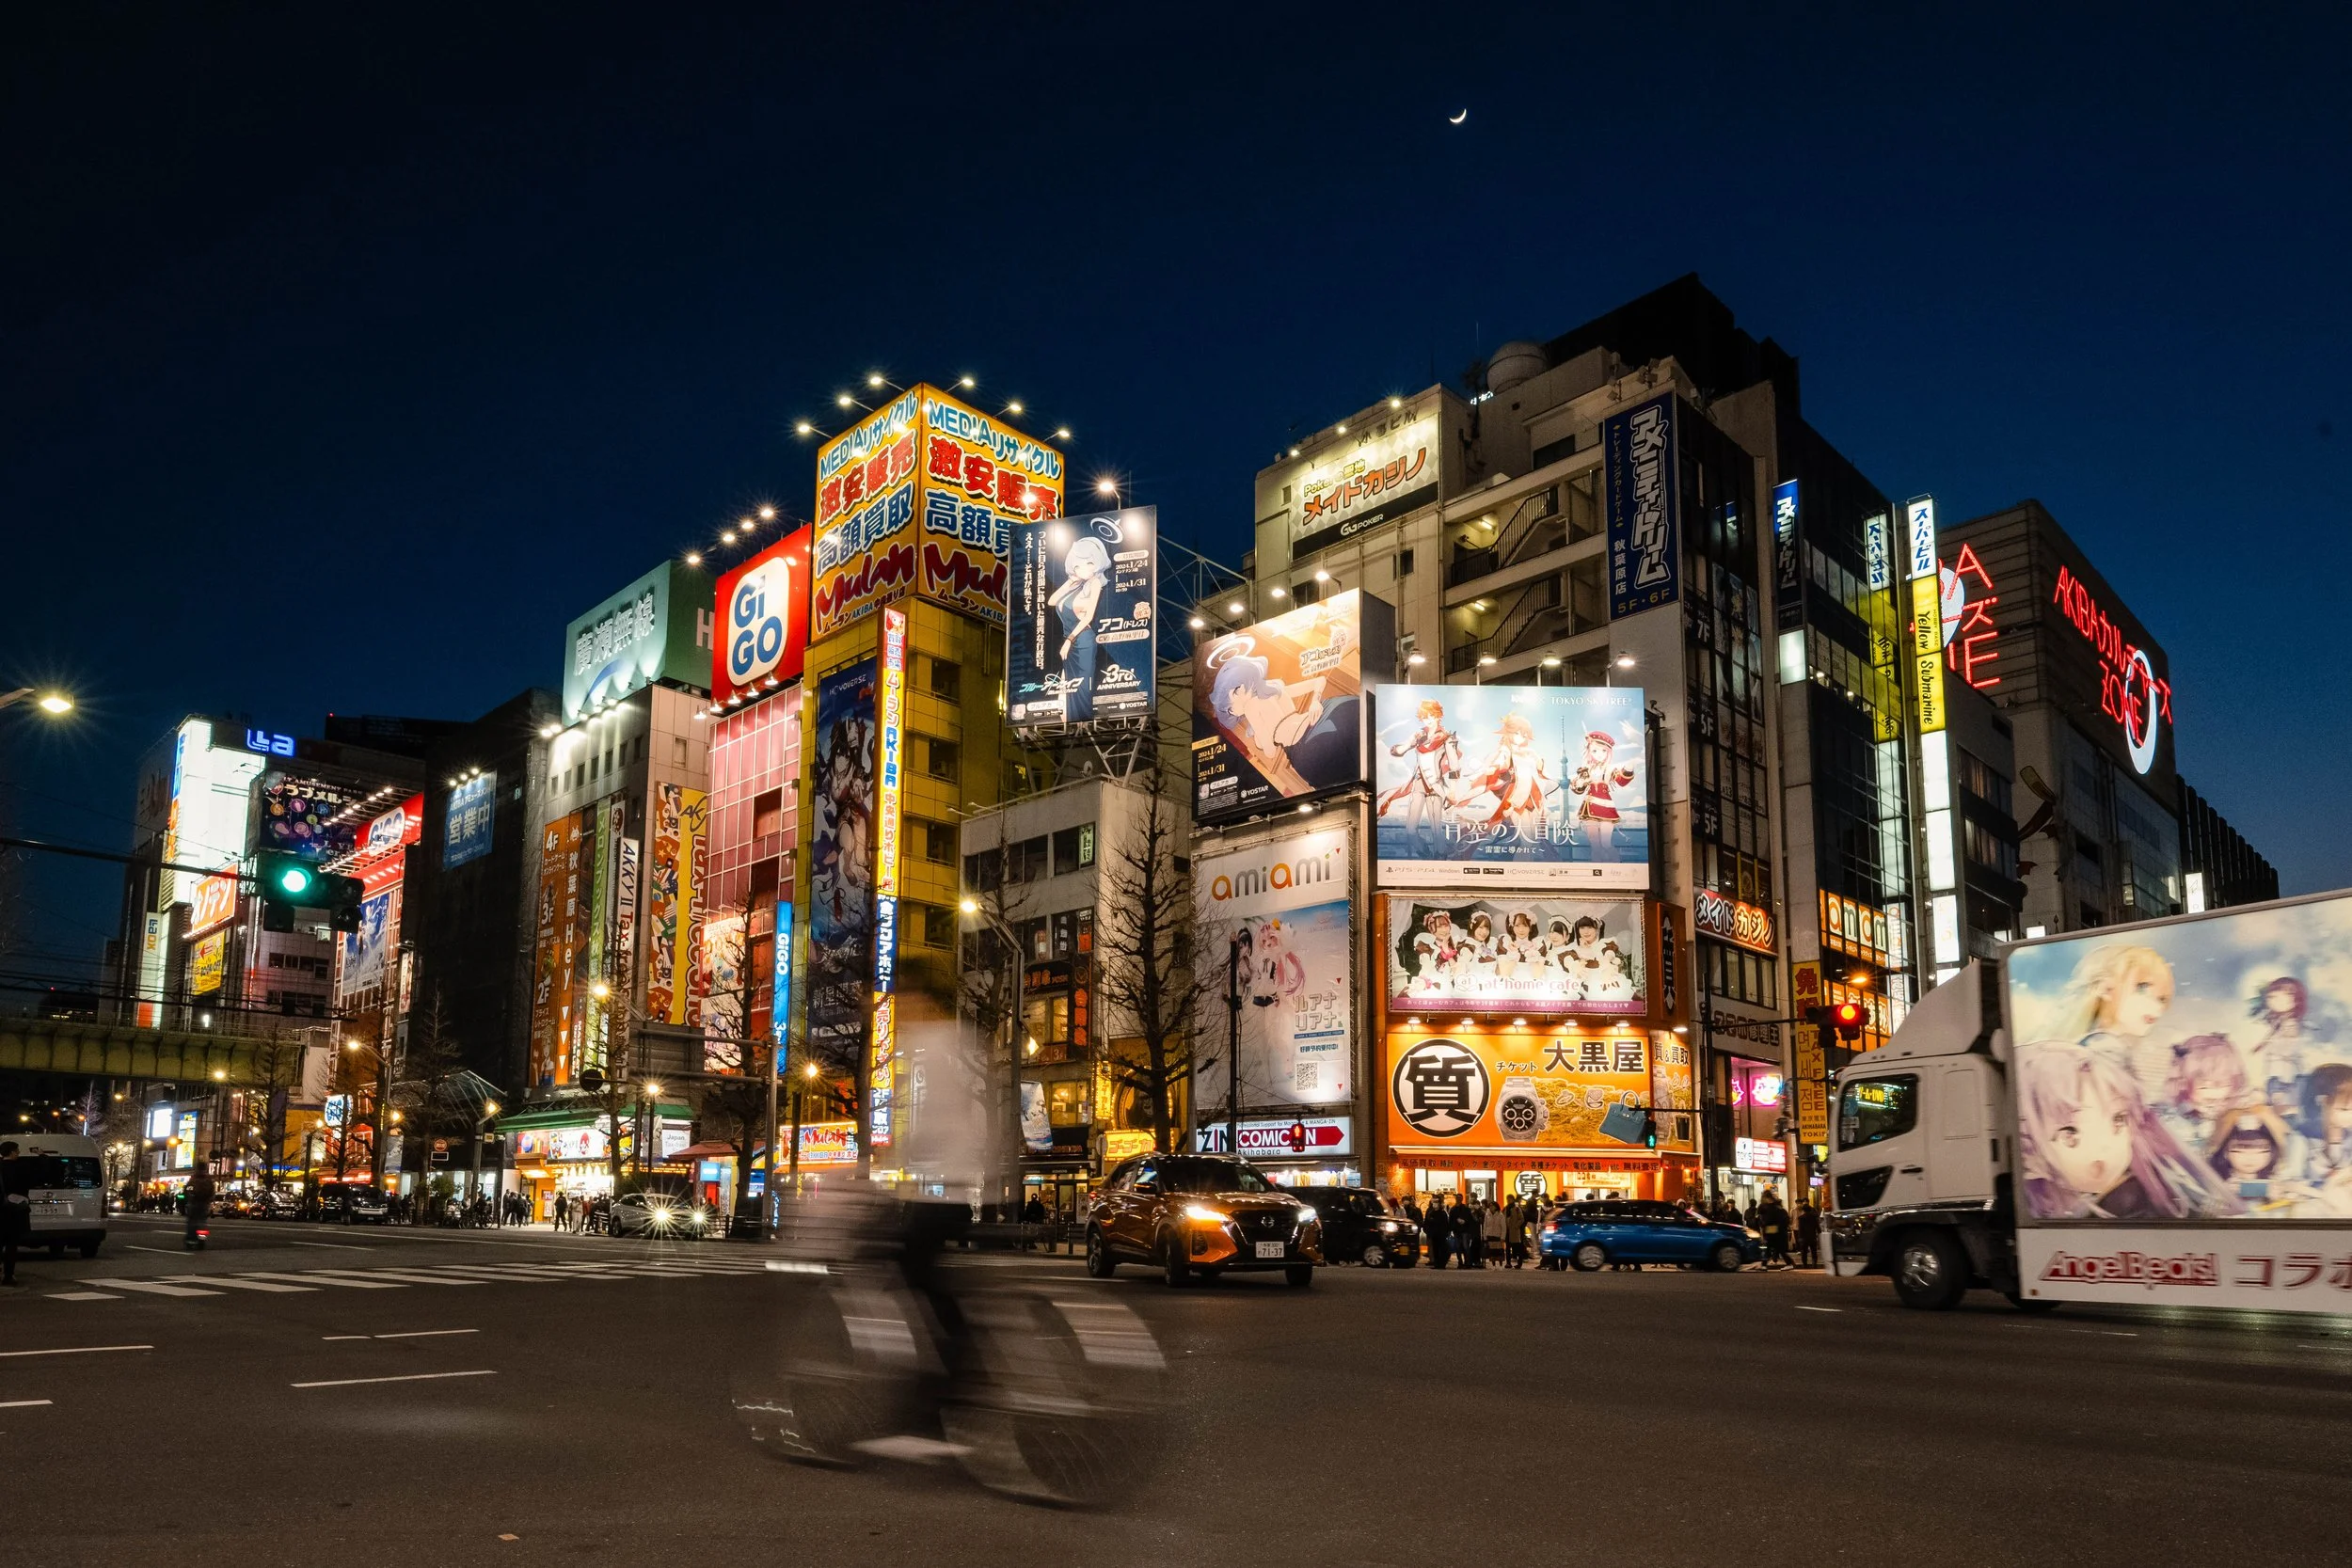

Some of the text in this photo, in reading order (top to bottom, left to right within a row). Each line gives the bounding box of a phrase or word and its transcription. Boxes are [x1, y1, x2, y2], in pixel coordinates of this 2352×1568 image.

[818, 429, 916, 526] 激安販売
[1303, 447, 1426, 526] メイドカジノ
[816, 481, 914, 578] 高額買取
[1613, 538, 1627, 595] 秋葉原店
[1917, 611, 1931, 650] Yellow
[1097, 681, 1141, 690] ANNIVERSARY
[1550, 696, 1583, 705] TOKYO
[1921, 660, 1934, 725] Submarine
[448, 801, 490, 847] 営業中
[546, 831, 559, 851] 4F
[1444, 814, 1579, 845] 青空の大冒険
[565, 851, 579, 917] 秋葉原
[622, 842, 635, 895] AKKY
[1212, 853, 1330, 900] amiami
[541, 903, 554, 925] 3F
[1696, 893, 1774, 948] メイドカジノ
[564, 923, 574, 990] Hey
[777, 933, 789, 975] GiGO
[537, 981, 549, 1004] 2F
[1549, 979, 1580, 990] cafe
[1496, 1061, 1537, 1072] チケット
[1544, 1040, 1645, 1073] 大黒屋
[1405, 1054, 1480, 1125] 質
[1239, 1130, 1290, 1147] COMIC
[1573, 1161, 1601, 1170] 電化製品
